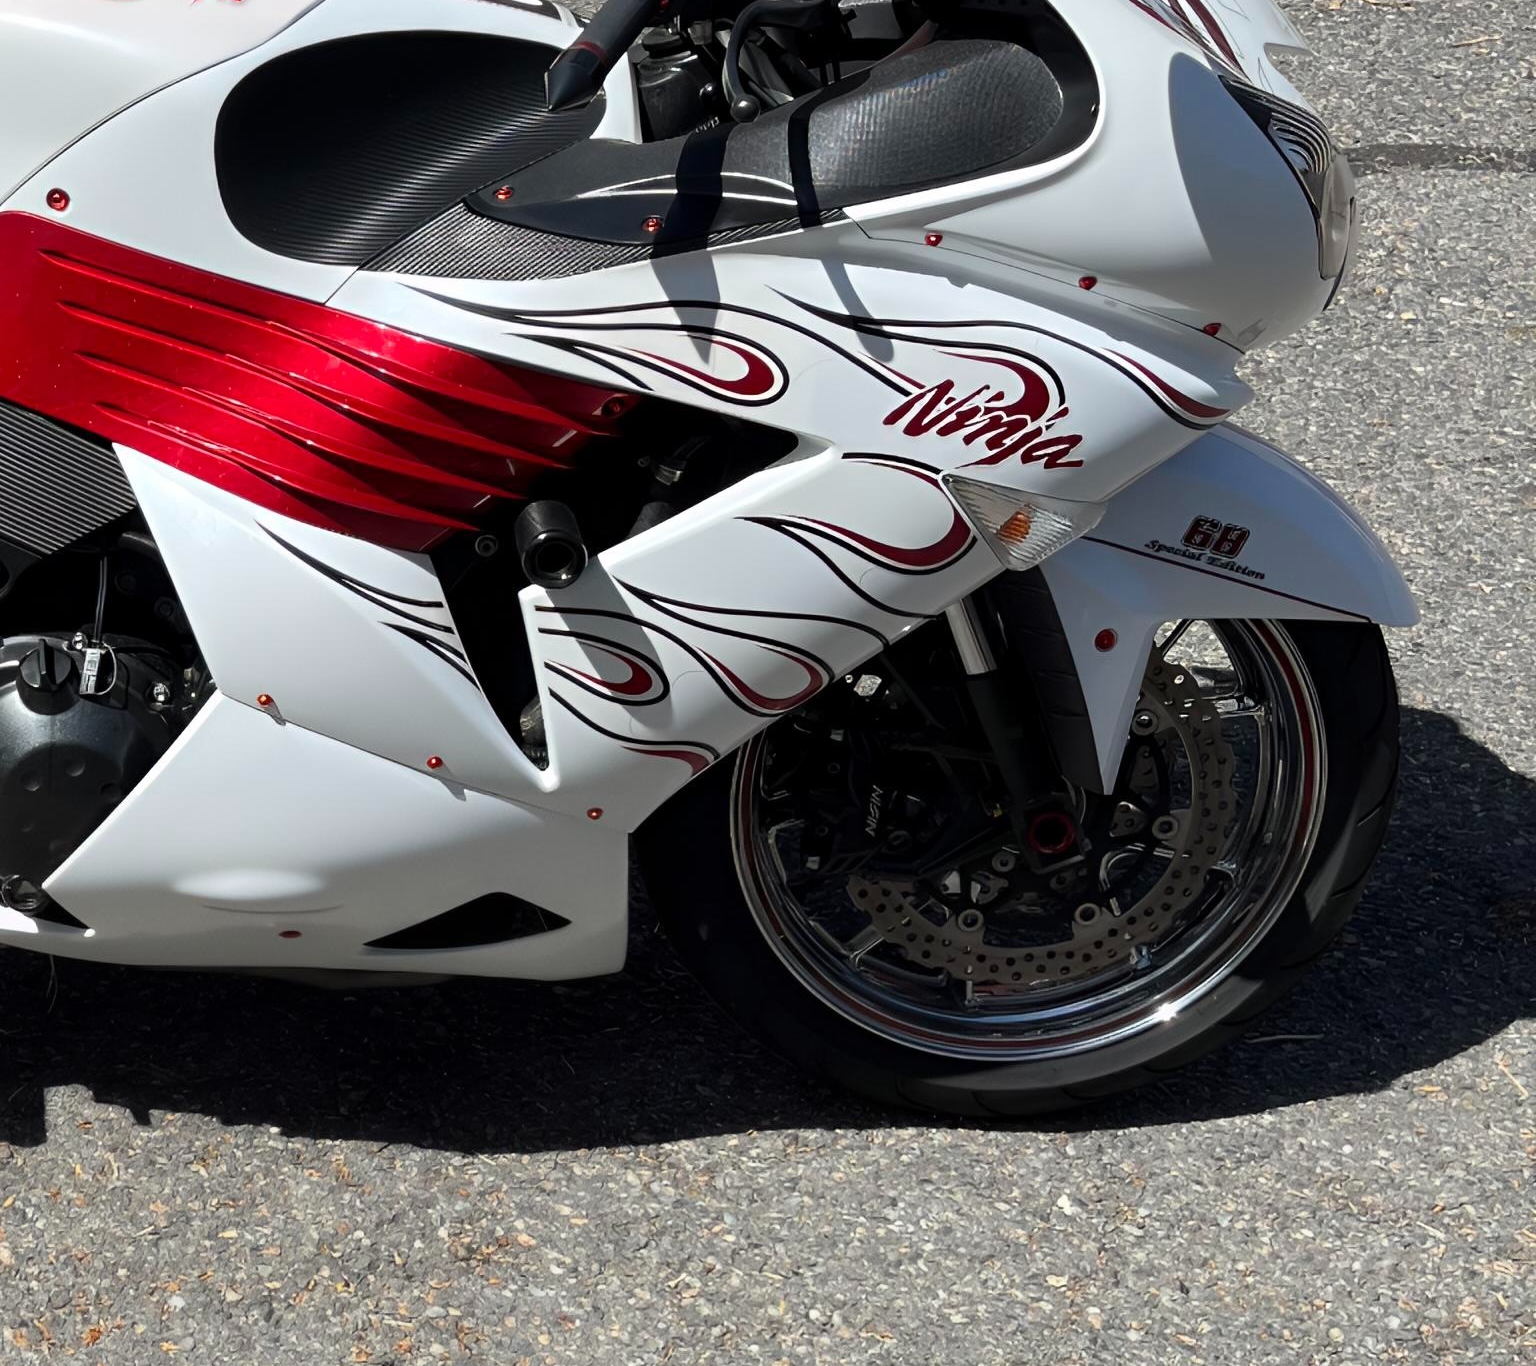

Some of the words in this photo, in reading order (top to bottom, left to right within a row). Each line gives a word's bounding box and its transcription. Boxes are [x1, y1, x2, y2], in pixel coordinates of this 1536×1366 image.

[882, 378, 1085, 470] Ninja
[1144, 538, 1207, 561] Special
[1206, 555, 1266, 580] Edition
